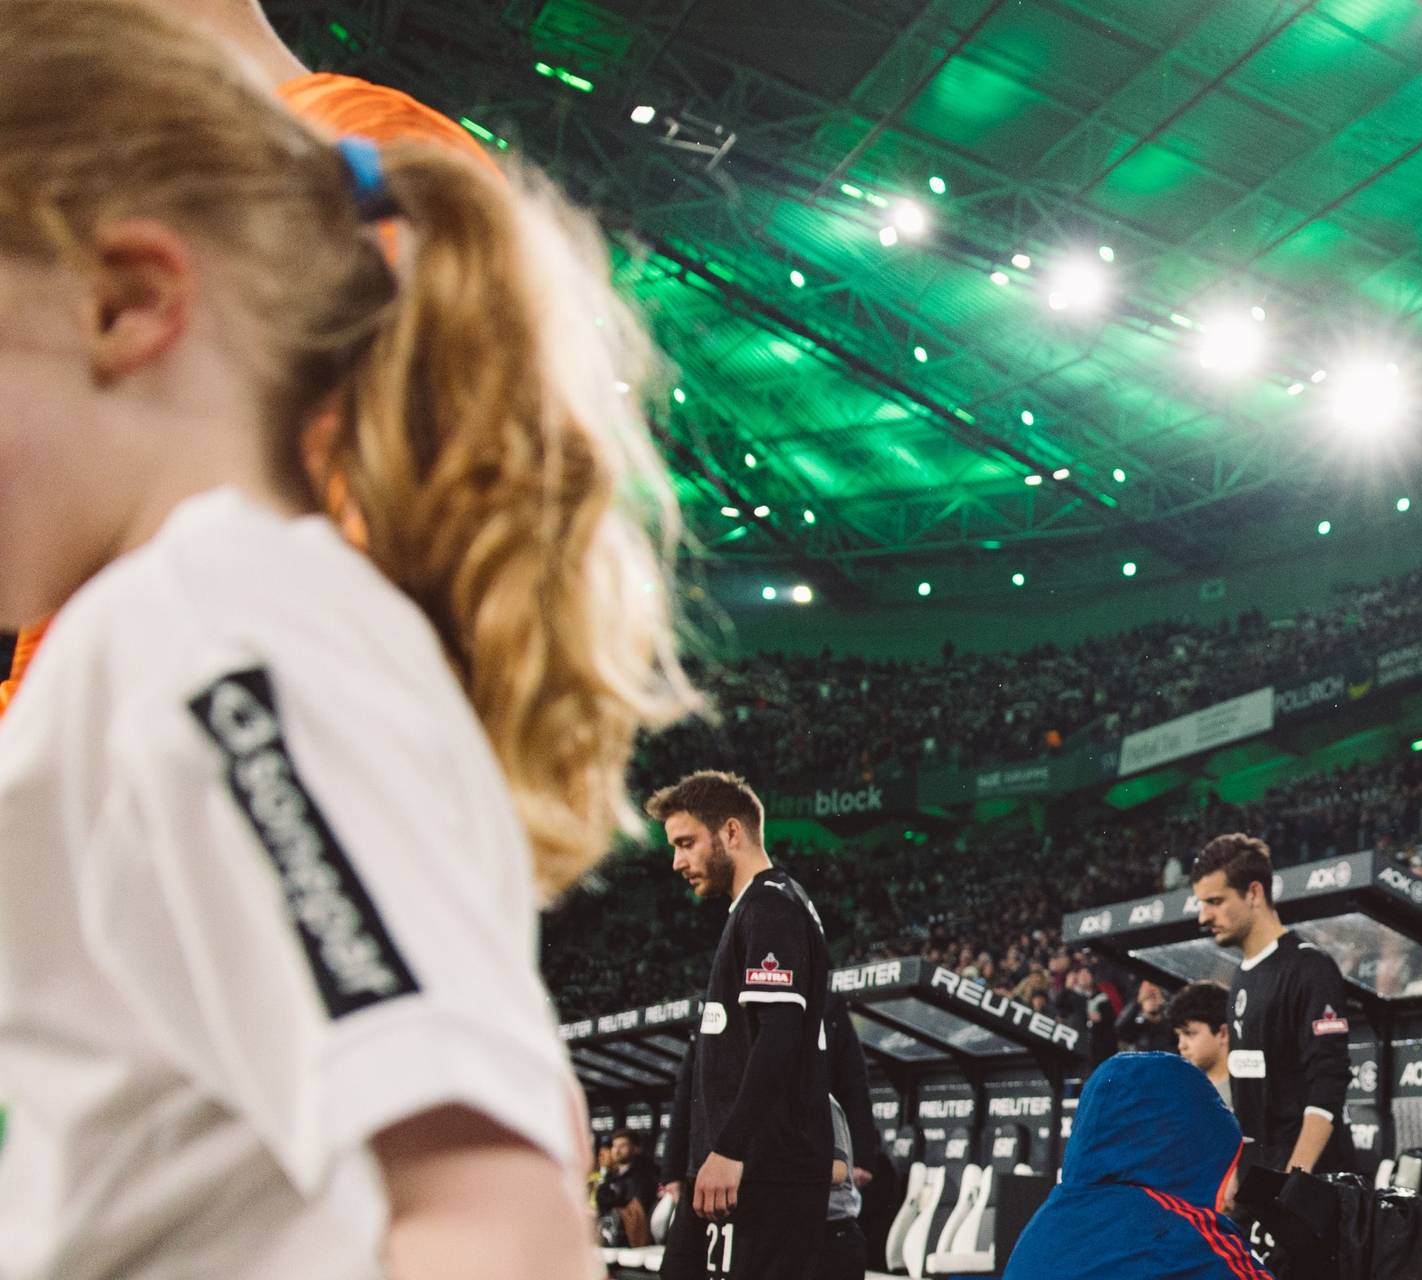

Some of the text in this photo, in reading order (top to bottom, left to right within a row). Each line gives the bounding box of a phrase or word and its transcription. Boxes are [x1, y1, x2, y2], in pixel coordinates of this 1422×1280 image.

[1306, 867, 1336, 891] AOK
[1378, 867, 1411, 894] AOK
[749, 971, 789, 983] ASTRA
[831, 960, 901, 993] REUTER
[645, 999, 690, 1025] REUTER
[931, 966, 1079, 1050] REUTER
[706, 1222, 734, 1273] 21
